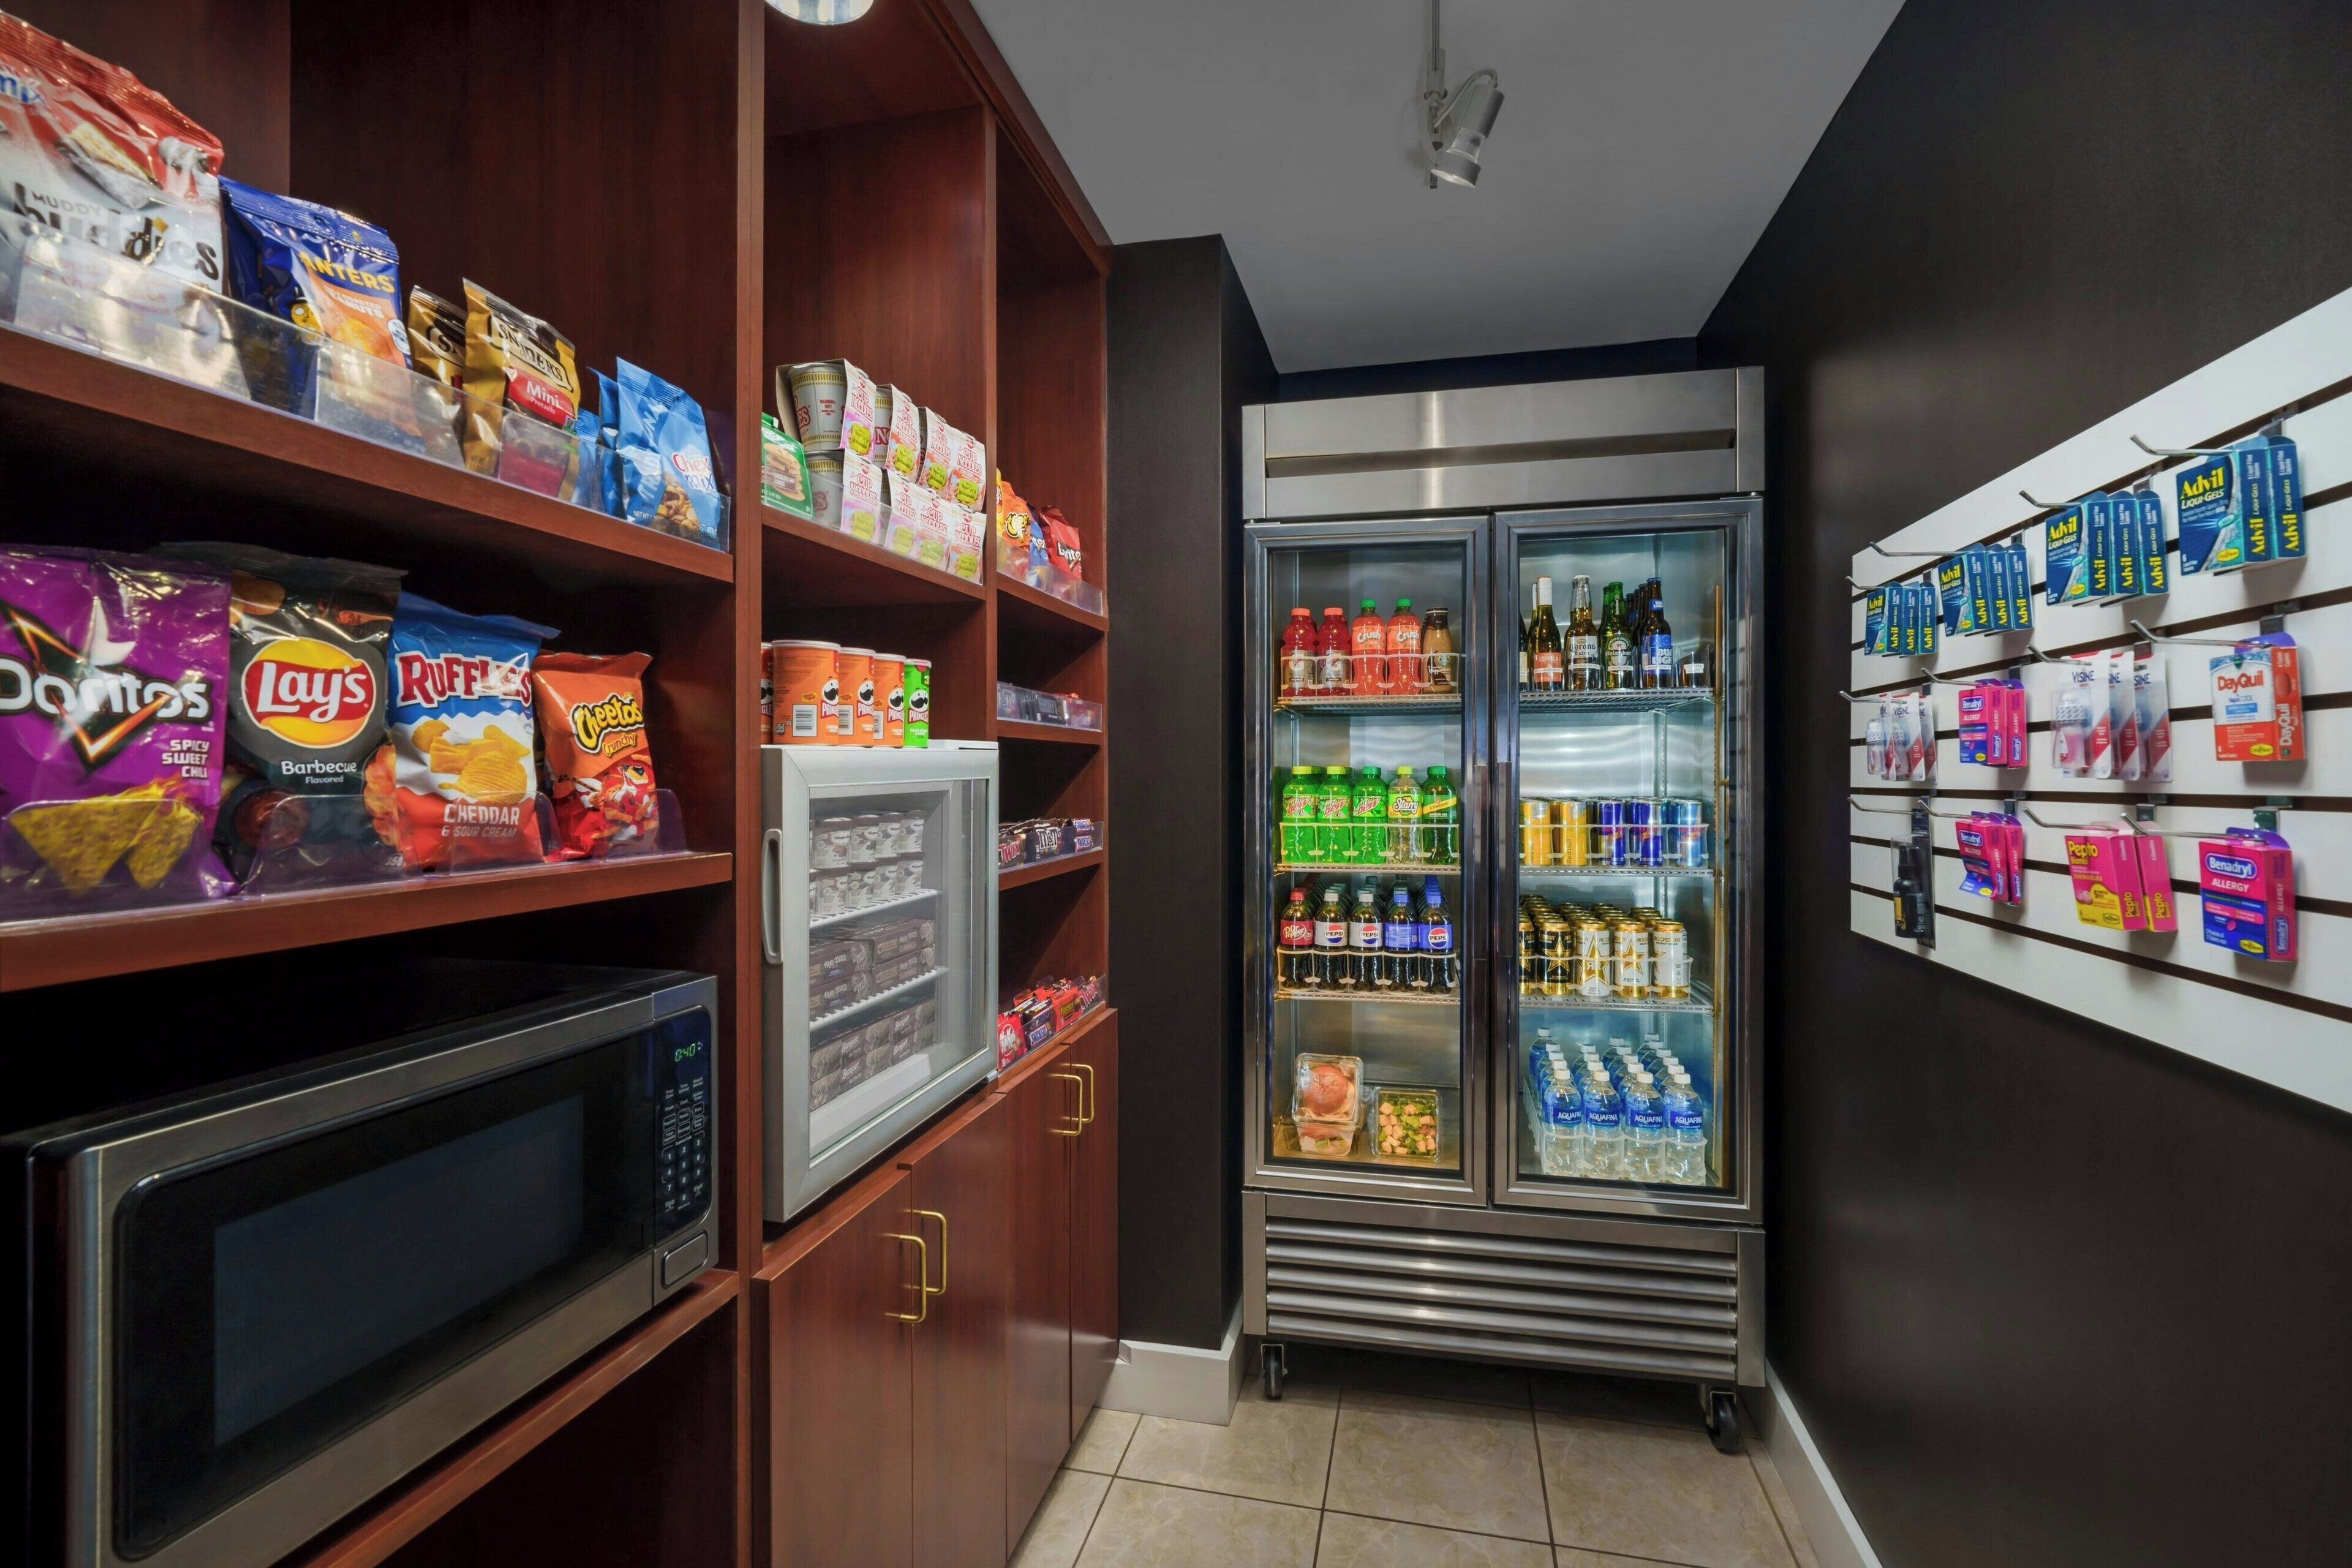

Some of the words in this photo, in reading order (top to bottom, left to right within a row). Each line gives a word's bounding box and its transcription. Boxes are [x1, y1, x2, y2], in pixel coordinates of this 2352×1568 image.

[32, 190, 101, 216] MUDDY
[298, 251, 395, 293] ANTERS
[527, 380, 560, 407] Mini
[673, 454, 712, 472] Chex
[857, 473, 873, 489] CUP
[2179, 466, 2225, 499] Advil
[2181, 489, 2225, 509] LIQUI-GELS
[927, 507, 943, 521] CUP
[960, 522, 977, 537] CUP
[2048, 515, 2078, 541] Advil
[2249, 518, 2265, 556] Advil
[2282, 514, 2299, 551] Advil
[1940, 564, 1961, 584] Advil
[2094, 559, 2106, 590] Advil
[2120, 557, 2133, 589] Advil
[2149, 556, 2164, 588] Advil
[1975, 598, 1987, 625] Advil
[1996, 599, 2008, 626] Advil
[2016, 598, 2028, 625] Advil
[1357, 630, 1381, 643] Crush
[1924, 627, 1932, 650] Advil
[1569, 643, 1596, 652] Corona
[2071, 670, 2096, 683] VISINE
[2134, 673, 2152, 686] SINE
[2217, 669, 2264, 694] DayQuil
[0, 662, 209, 718] Doritos
[256, 662, 368, 723] Lay's
[1893, 706, 1910, 715] VISINE
[1962, 699, 1982, 709] Benadryl
[573, 696, 643, 748] Cheetos
[2277, 703, 2295, 746] DayQuil
[170, 739, 209, 752] SPICY
[602, 733, 637, 757] Crunchy
[162, 752, 208, 764] SWEET
[281, 760, 357, 775] Barbecue
[305, 775, 344, 784] Flavored
[443, 804, 520, 826] CHEDDAR
[1393, 797, 1419, 814] Starry
[453, 826, 480, 837] SOUR
[482, 827, 517, 838] CREAM
[2067, 840, 2098, 859] Pepto
[2209, 856, 2252, 879] Benadryl
[2211, 878, 2250, 892] ALLERGY
[2124, 892, 2135, 918] Pepto
[2154, 892, 2165, 918] Pepto
[1284, 926, 1305, 939] Pepper
[1558, 1111, 1581, 1120] AQUAFIN
[1589, 1112, 1618, 1121] AQUAFINA
[1634, 1114, 1663, 1124] AQUAFINA
